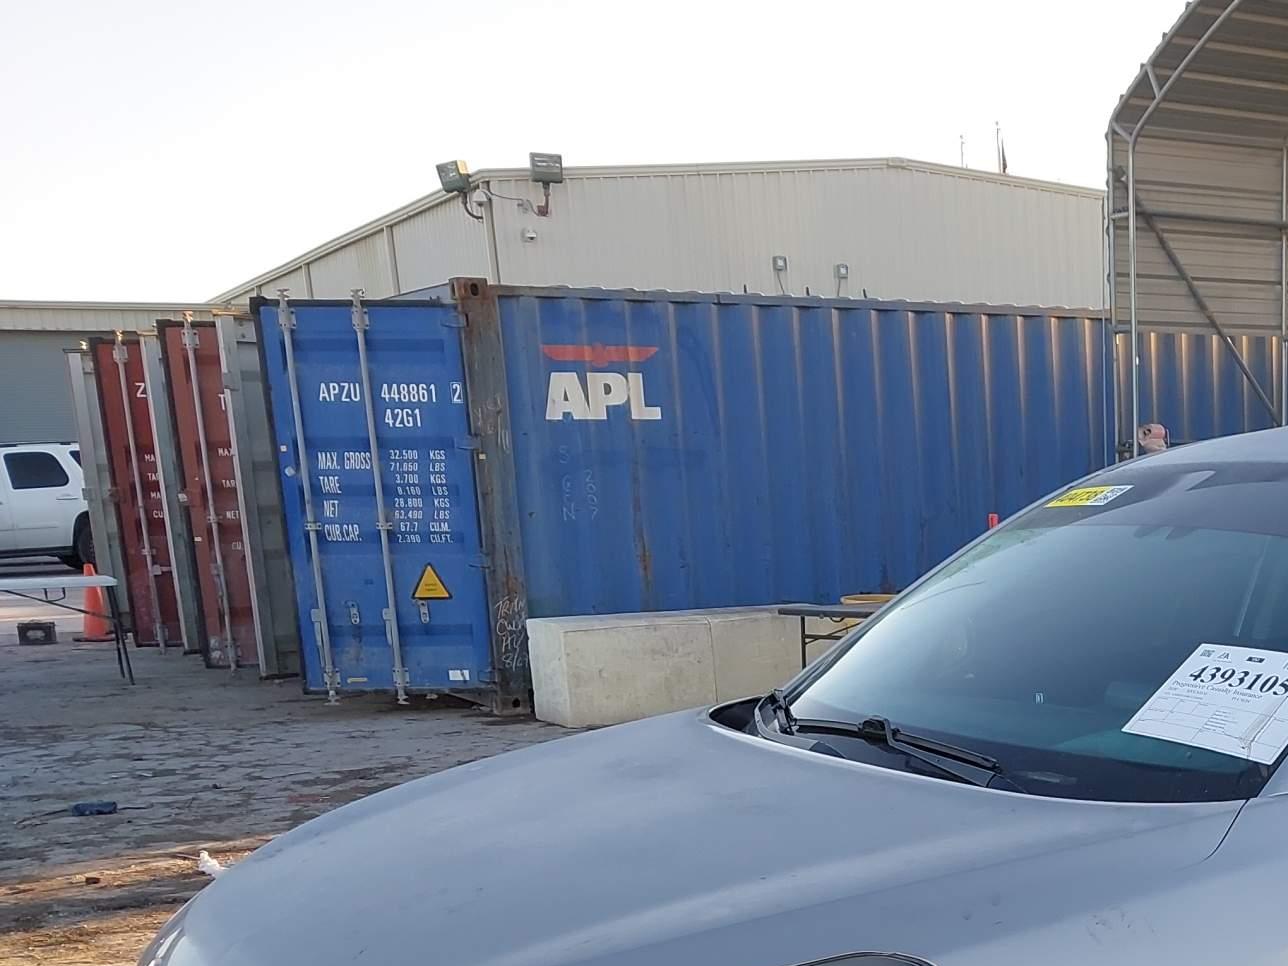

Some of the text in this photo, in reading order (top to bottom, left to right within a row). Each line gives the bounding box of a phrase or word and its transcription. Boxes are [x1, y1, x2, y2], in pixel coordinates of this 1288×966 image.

[319, 382, 462, 402] APZU 448861 2
[545, 371, 662, 420] APL
[384, 408, 422, 428] 42G1
[318, 451, 371, 470] MAX. GROSS
[429, 450, 446, 460] KGS
[429, 462, 446, 472] LBS
[429, 474, 446, 484] KGS
[318, 476, 342, 494] TARE
[432, 486, 449, 496] LBS
[434, 498, 450, 508] KGS
[323, 500, 339, 518] NET
[434, 510, 450, 520] LBS
[324, 523, 362, 542] CUB.CAP.
[400, 522, 418, 532] 67.7
[1232, 688, 1263, 699] Insurance
